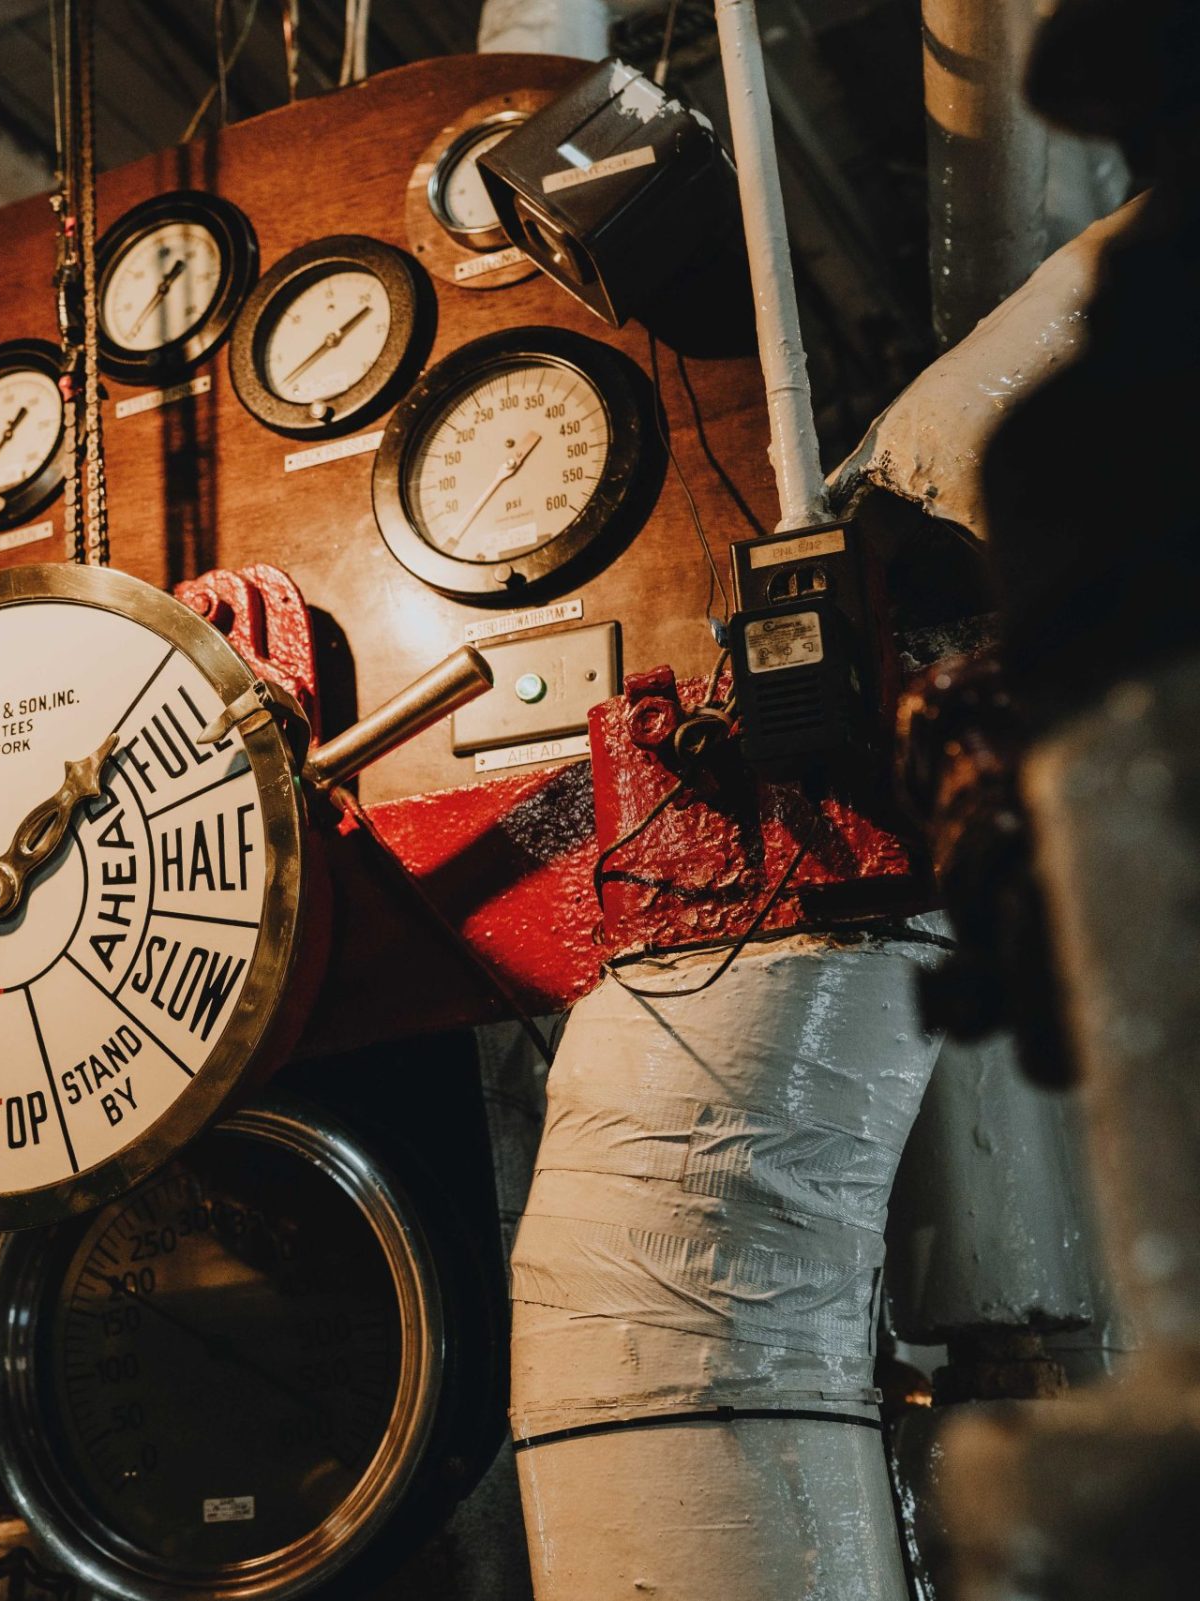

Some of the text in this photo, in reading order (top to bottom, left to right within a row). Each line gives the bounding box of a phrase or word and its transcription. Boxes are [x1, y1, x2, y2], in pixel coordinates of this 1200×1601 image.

[500, 395, 519, 412] 300
[524, 393, 545, 410] 350
[473, 406, 494, 425] 250
[545, 403, 565, 419] 400
[455, 426, 476, 444] 200
[559, 419, 581, 437] 450
[566, 441, 588, 457] 500
[443, 450, 462, 467] 150
[438, 476, 456, 492] 100
[562, 467, 584, 484] 550
[545, 493, 568, 512] 600
[3, 702, 15, 719] &
[125, 685, 235, 794] FULL
[508, 742, 563, 764] AHEAD
[161, 802, 255, 892] HALF
[83, 783, 137, 972] AHEAD
[132, 936, 248, 1043] SLOW
[61, 1024, 143, 1105] STAND
[101, 1078, 139, 1127] BY
